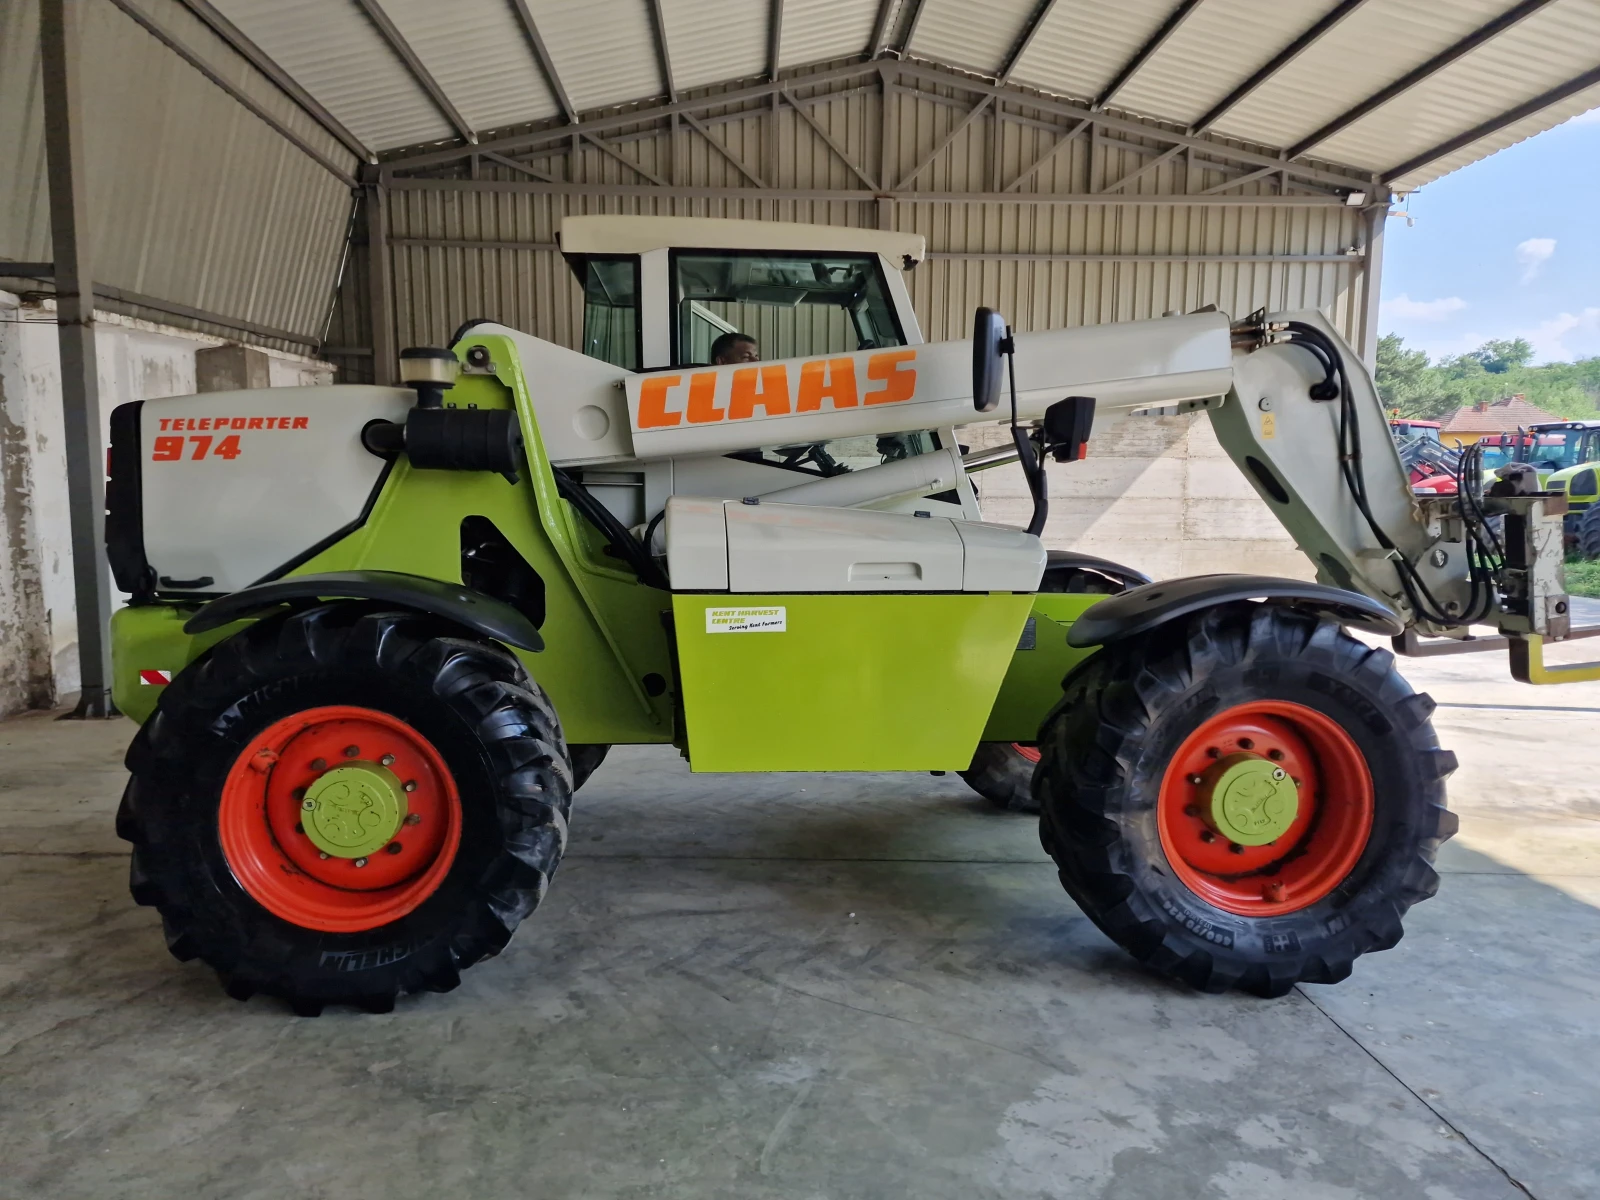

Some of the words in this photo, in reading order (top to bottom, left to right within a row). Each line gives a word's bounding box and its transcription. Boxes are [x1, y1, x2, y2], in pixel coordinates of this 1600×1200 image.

[637, 350, 917, 429] CLAAS
[159, 417, 309, 431] TELEPORTER
[152, 435, 242, 461] 974
